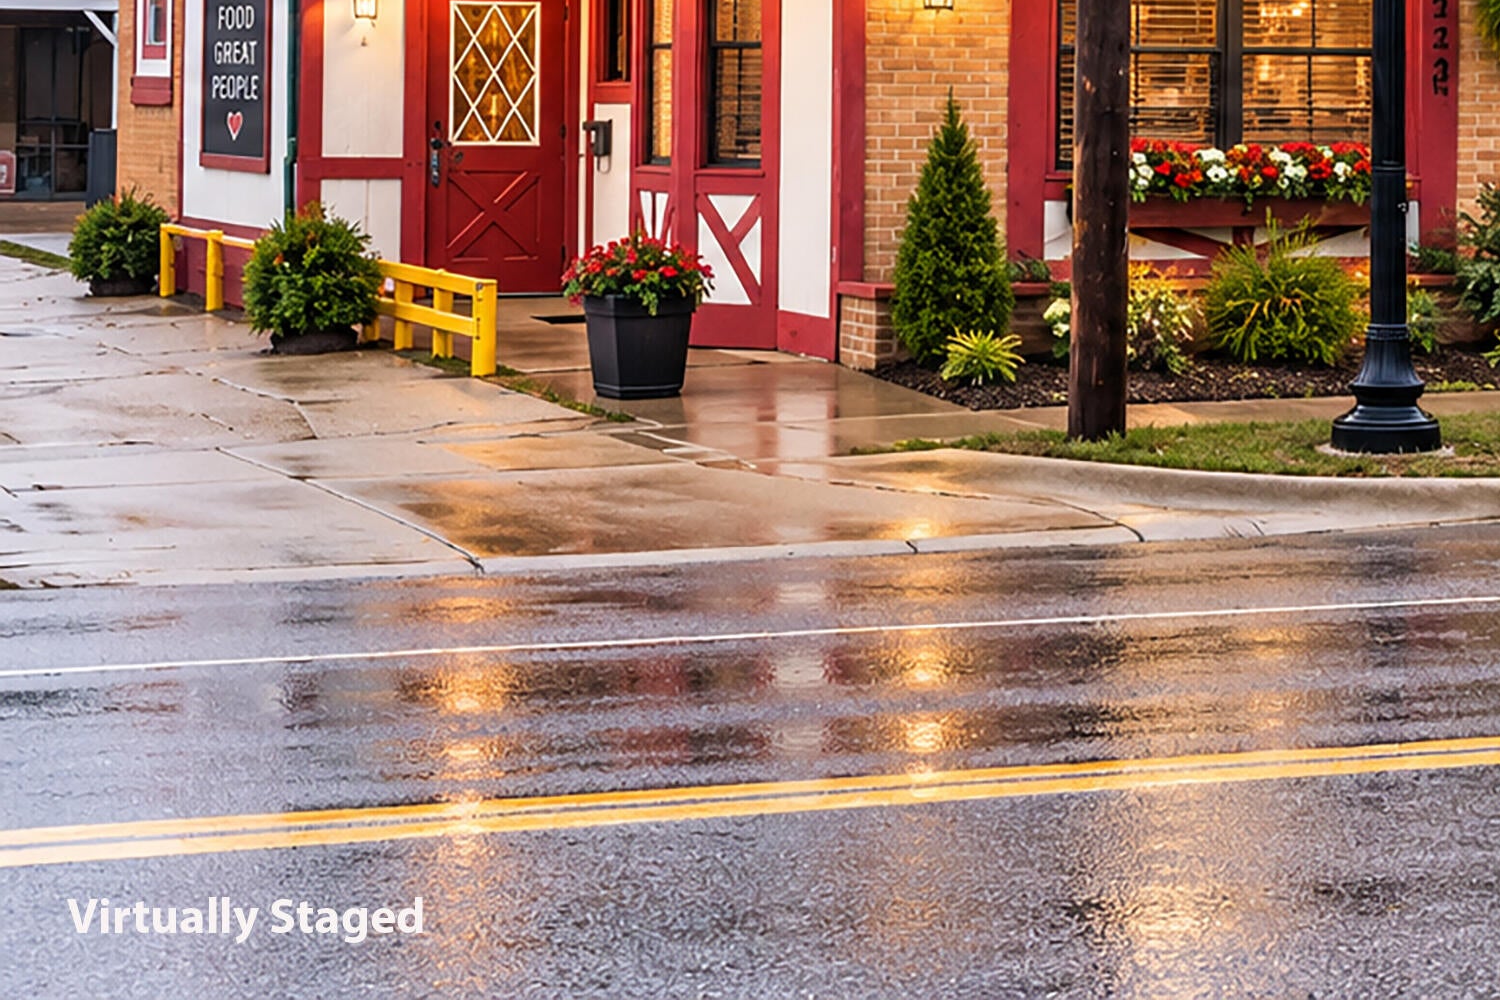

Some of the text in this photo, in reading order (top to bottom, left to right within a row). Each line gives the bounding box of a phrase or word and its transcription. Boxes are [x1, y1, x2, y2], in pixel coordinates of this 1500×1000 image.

[218, 5, 254, 30] FOOD
[214, 41, 257, 65] GREAT
[212, 75, 258, 100] PEOPLE
